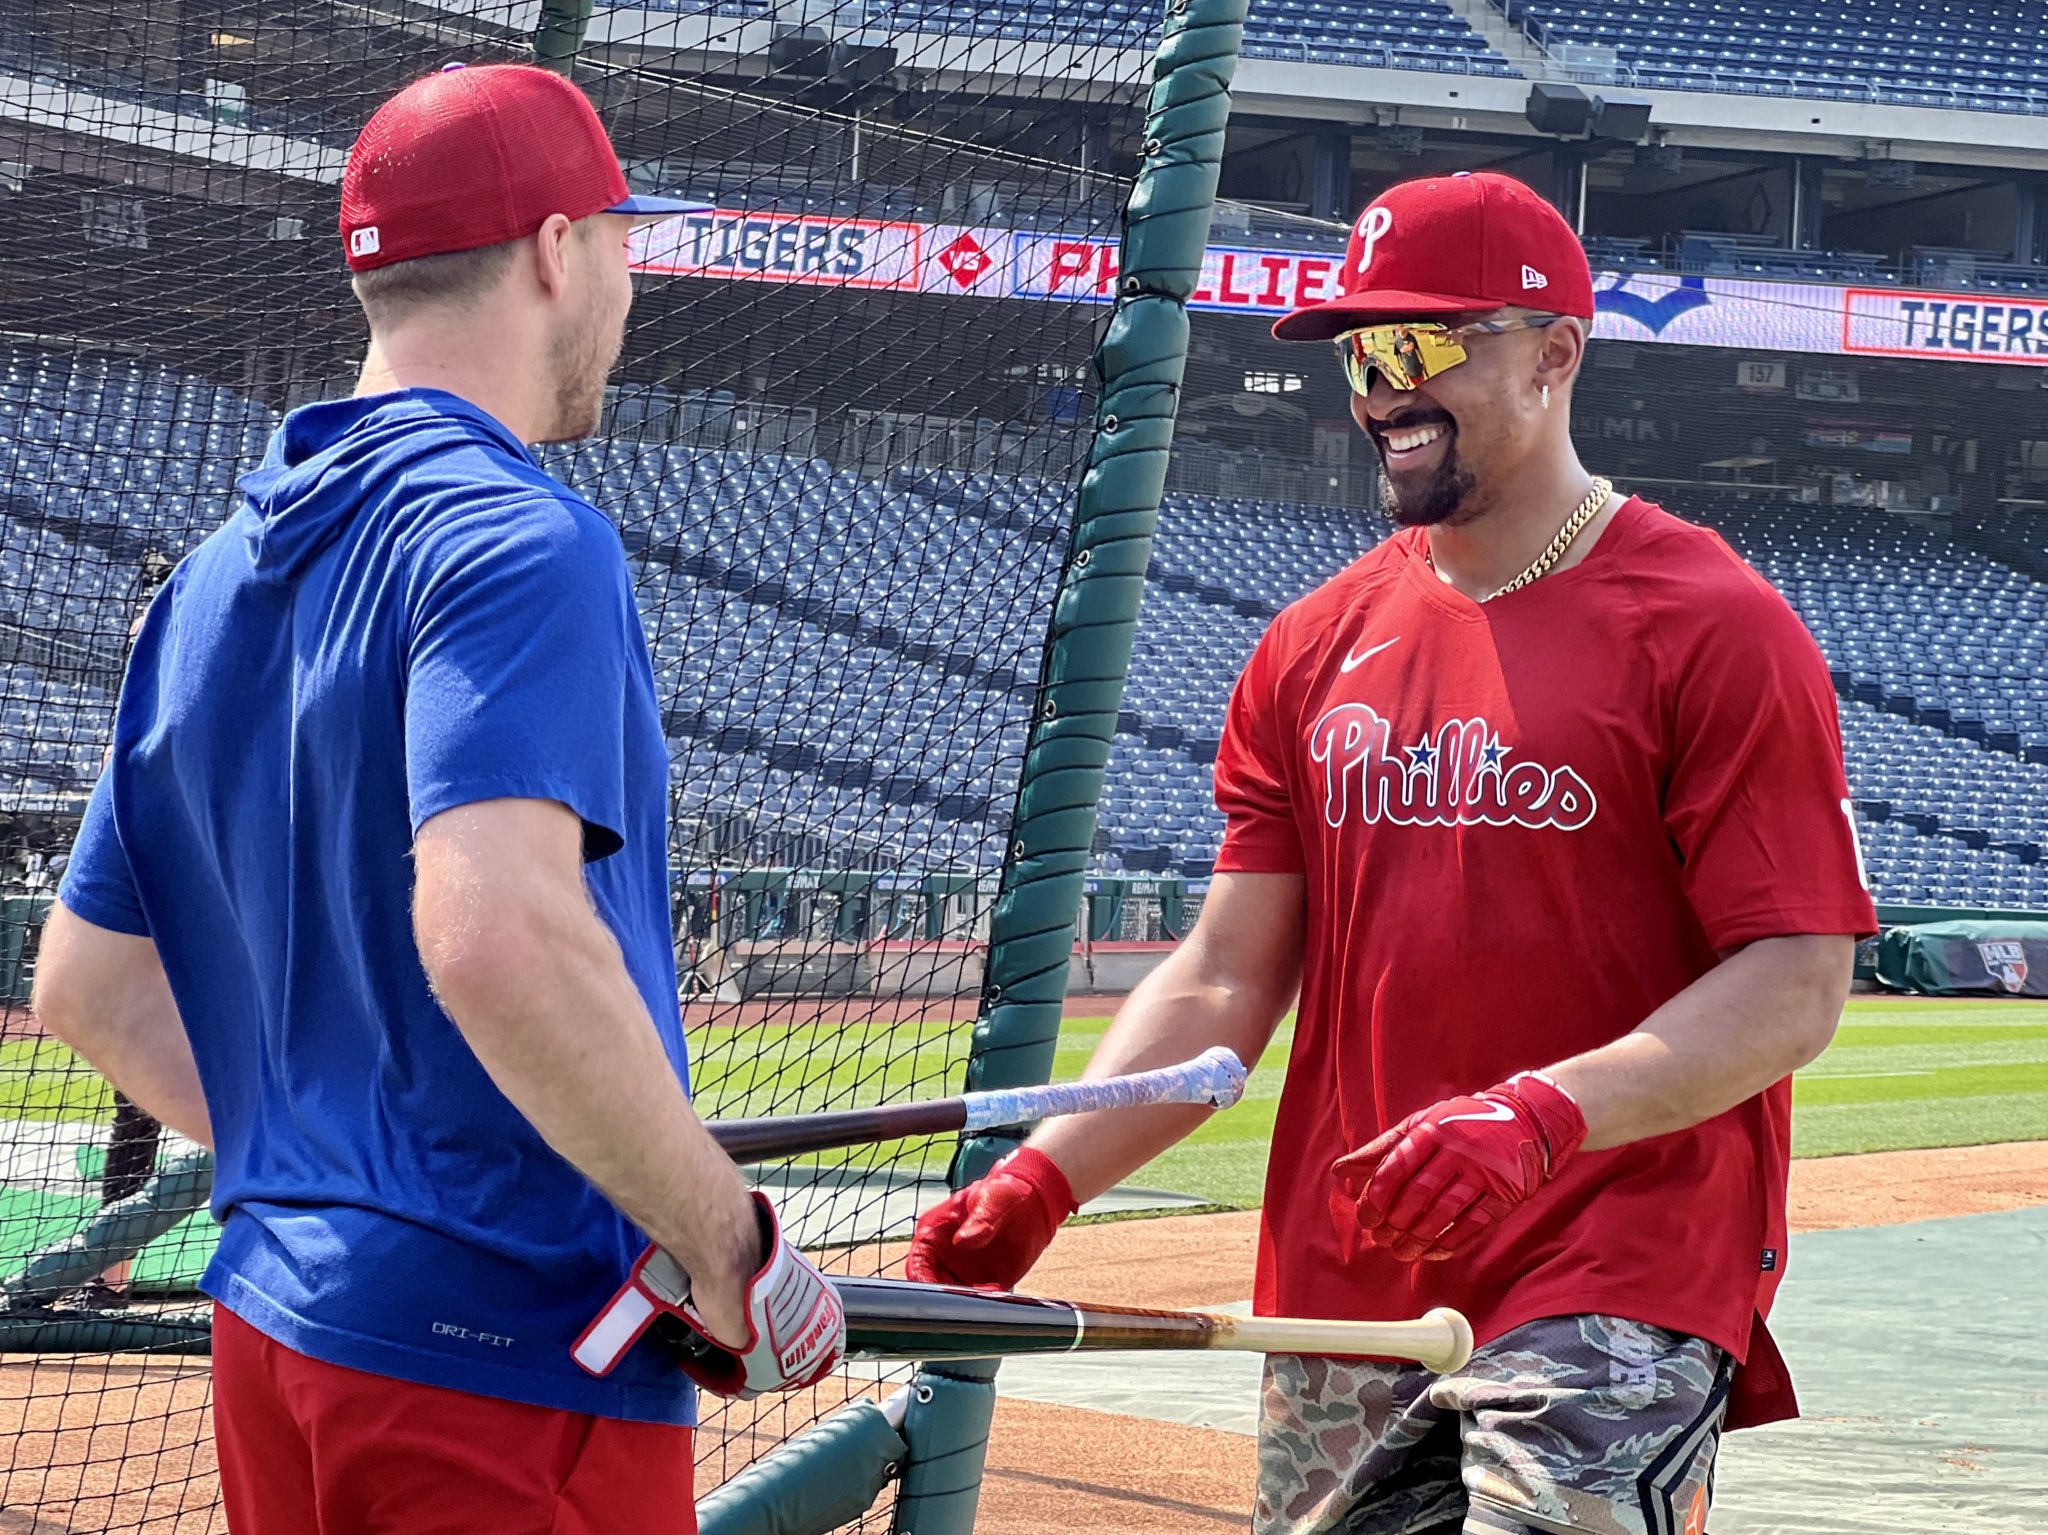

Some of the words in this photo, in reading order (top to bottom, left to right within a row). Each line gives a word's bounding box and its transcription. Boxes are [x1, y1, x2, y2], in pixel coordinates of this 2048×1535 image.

[685, 216, 866, 275] TIGERS
[1357, 206, 1393, 274] P
[1310, 702, 1598, 832] Phillies
[1131, 882, 1161, 895] RE/MAX
[1981, 945, 2021, 961] MLB
[432, 1322, 515, 1348] DRI-FIT
